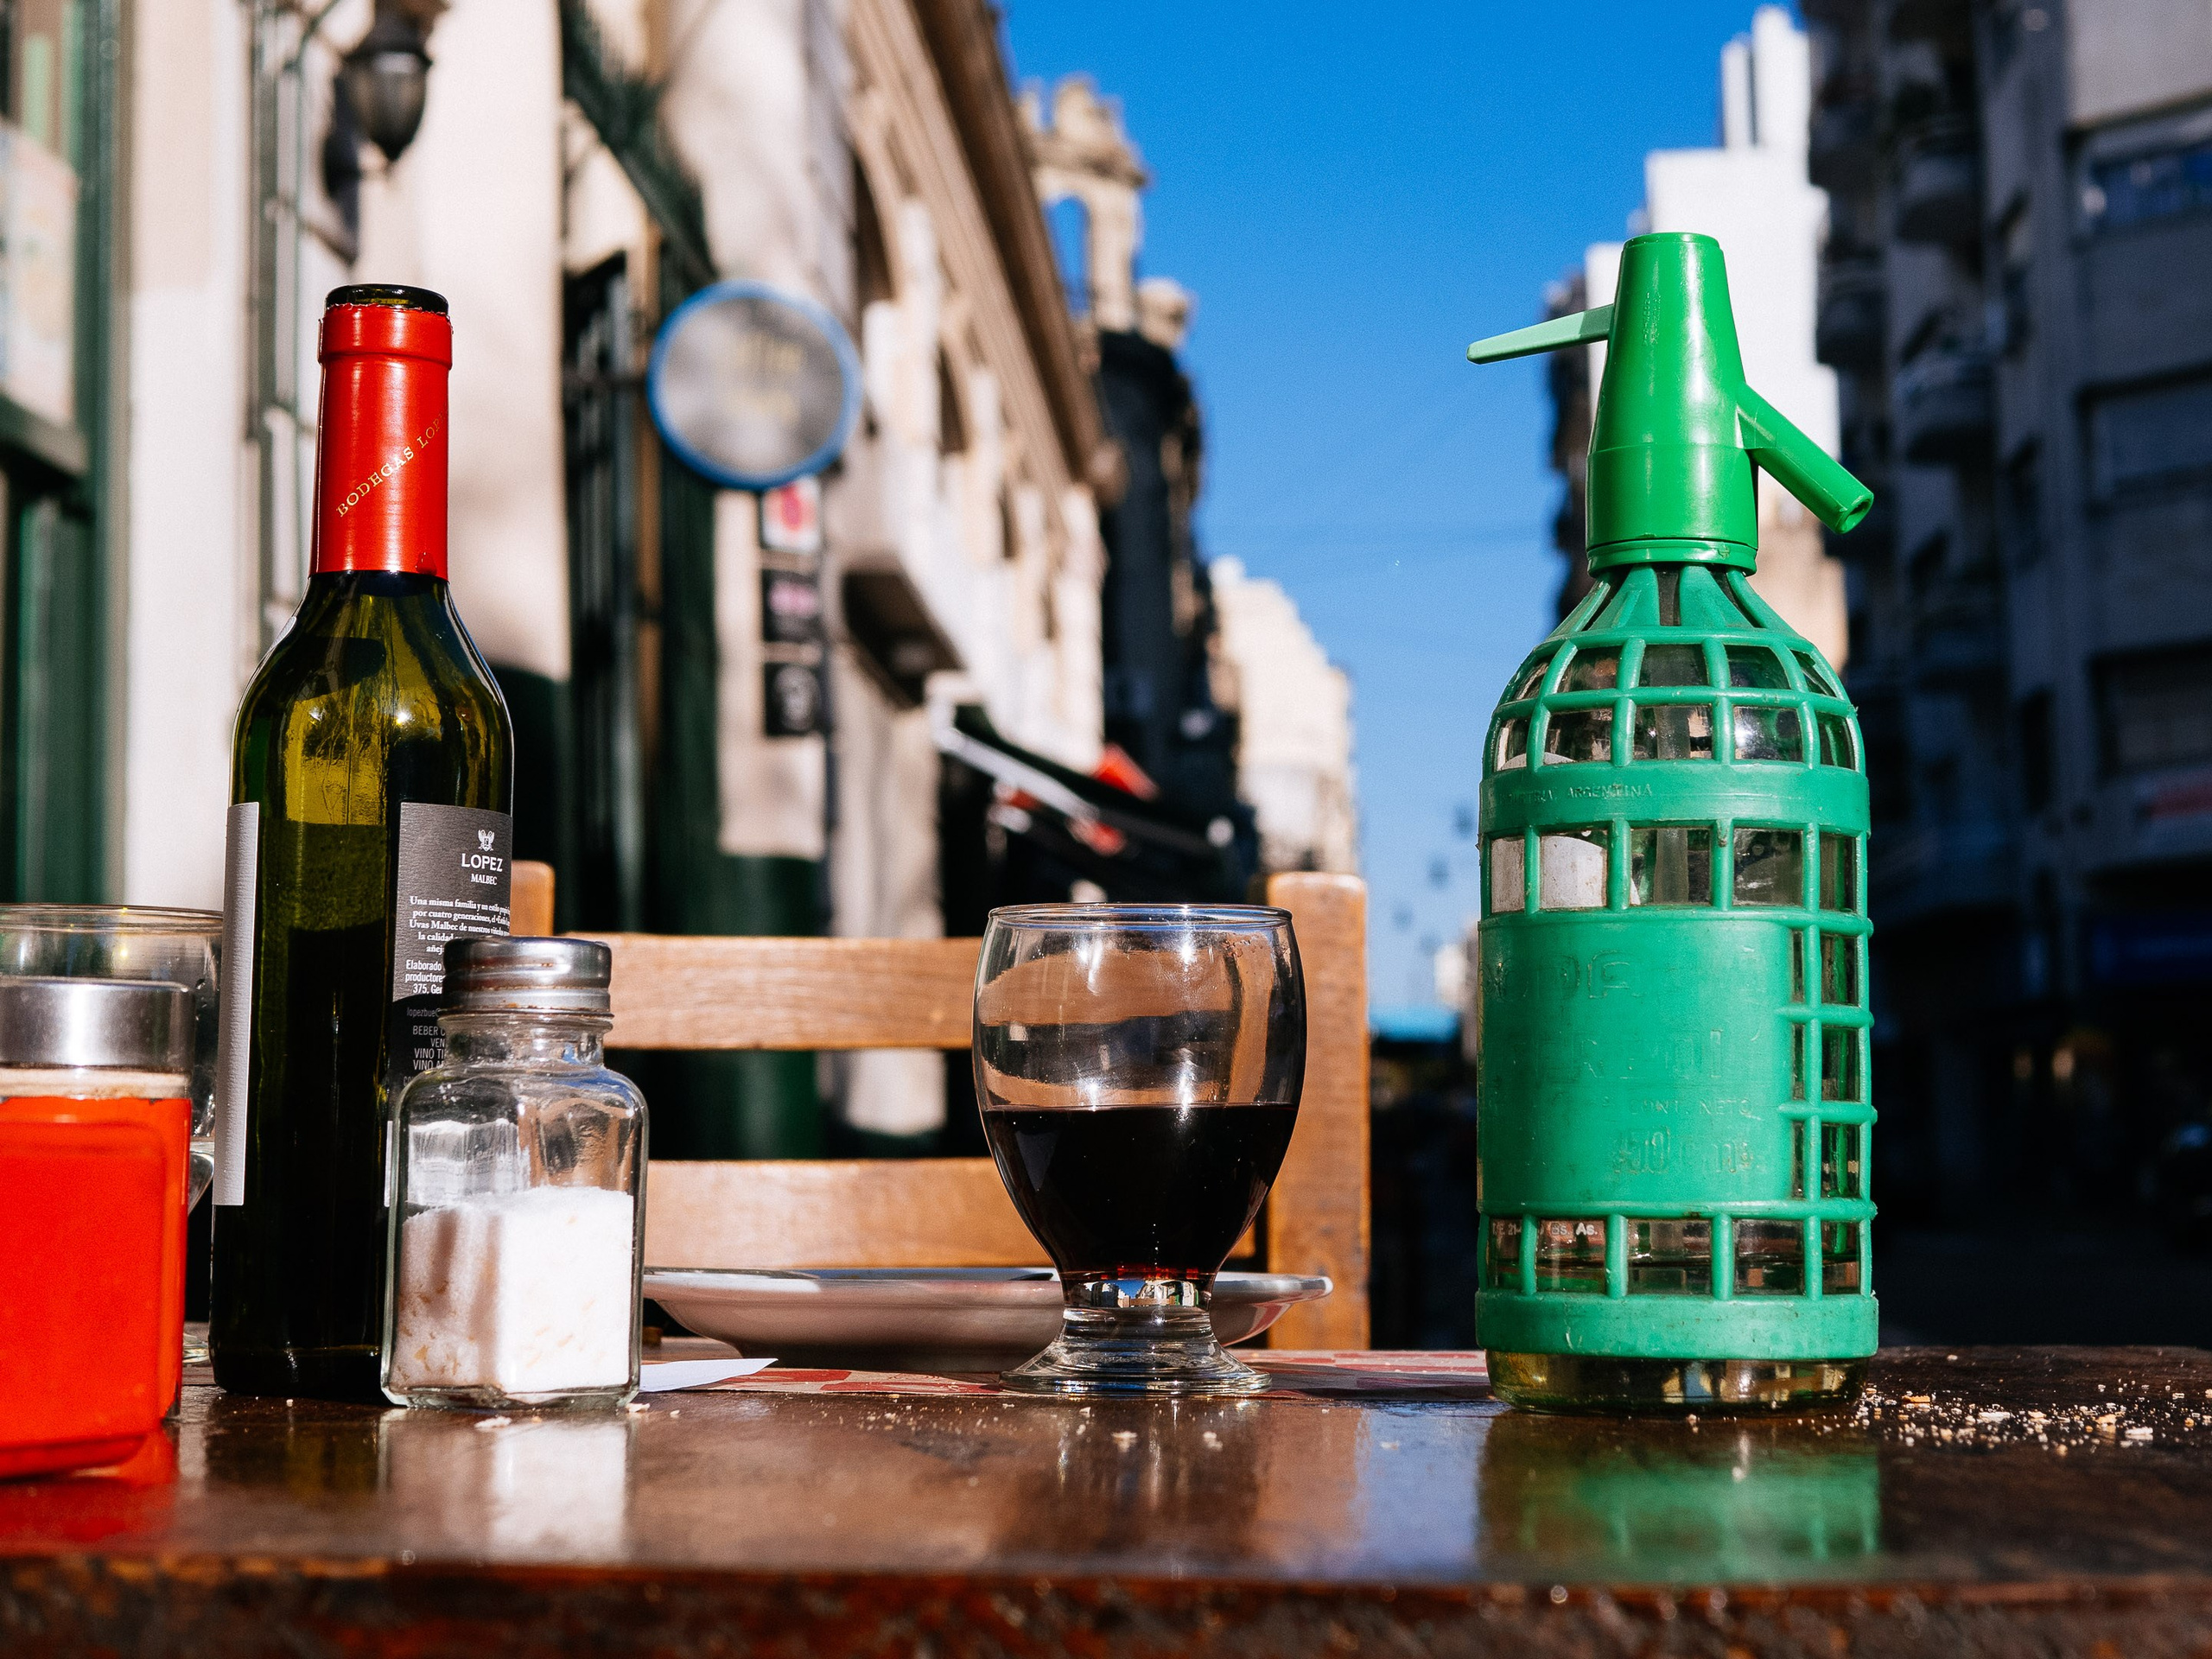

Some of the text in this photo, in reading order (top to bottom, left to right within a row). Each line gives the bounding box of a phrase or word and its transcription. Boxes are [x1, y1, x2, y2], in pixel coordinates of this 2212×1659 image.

[336, 447, 414, 517] BODEGAS
[1567, 784, 1652, 799] ARGENTINA
[461, 853, 504, 873] LOPEZ
[470, 873, 498, 886] MALBEC
[410, 895, 428, 906] Una
[429, 899, 454, 908] misma
[454, 899, 477, 909] familia
[477, 903, 481, 912] y
[413, 910, 428, 919] por
[410, 918, 429, 929] Uvas
[431, 920, 459, 931] Malbec
[459, 922, 467, 931] de
[468, 925, 490, 934] nuestros
[418, 931, 454, 942] la calidad
[426, 944, 444, 956] añej
[406, 959, 442, 971] Elaborado
[413, 982, 429, 995] 375.
[413, 1025, 438, 1036] BEBER
[414, 1047, 435, 1059] VINO
[413, 1059, 434, 1071] VINO
[1575, 1221, 1599, 1236] As.
